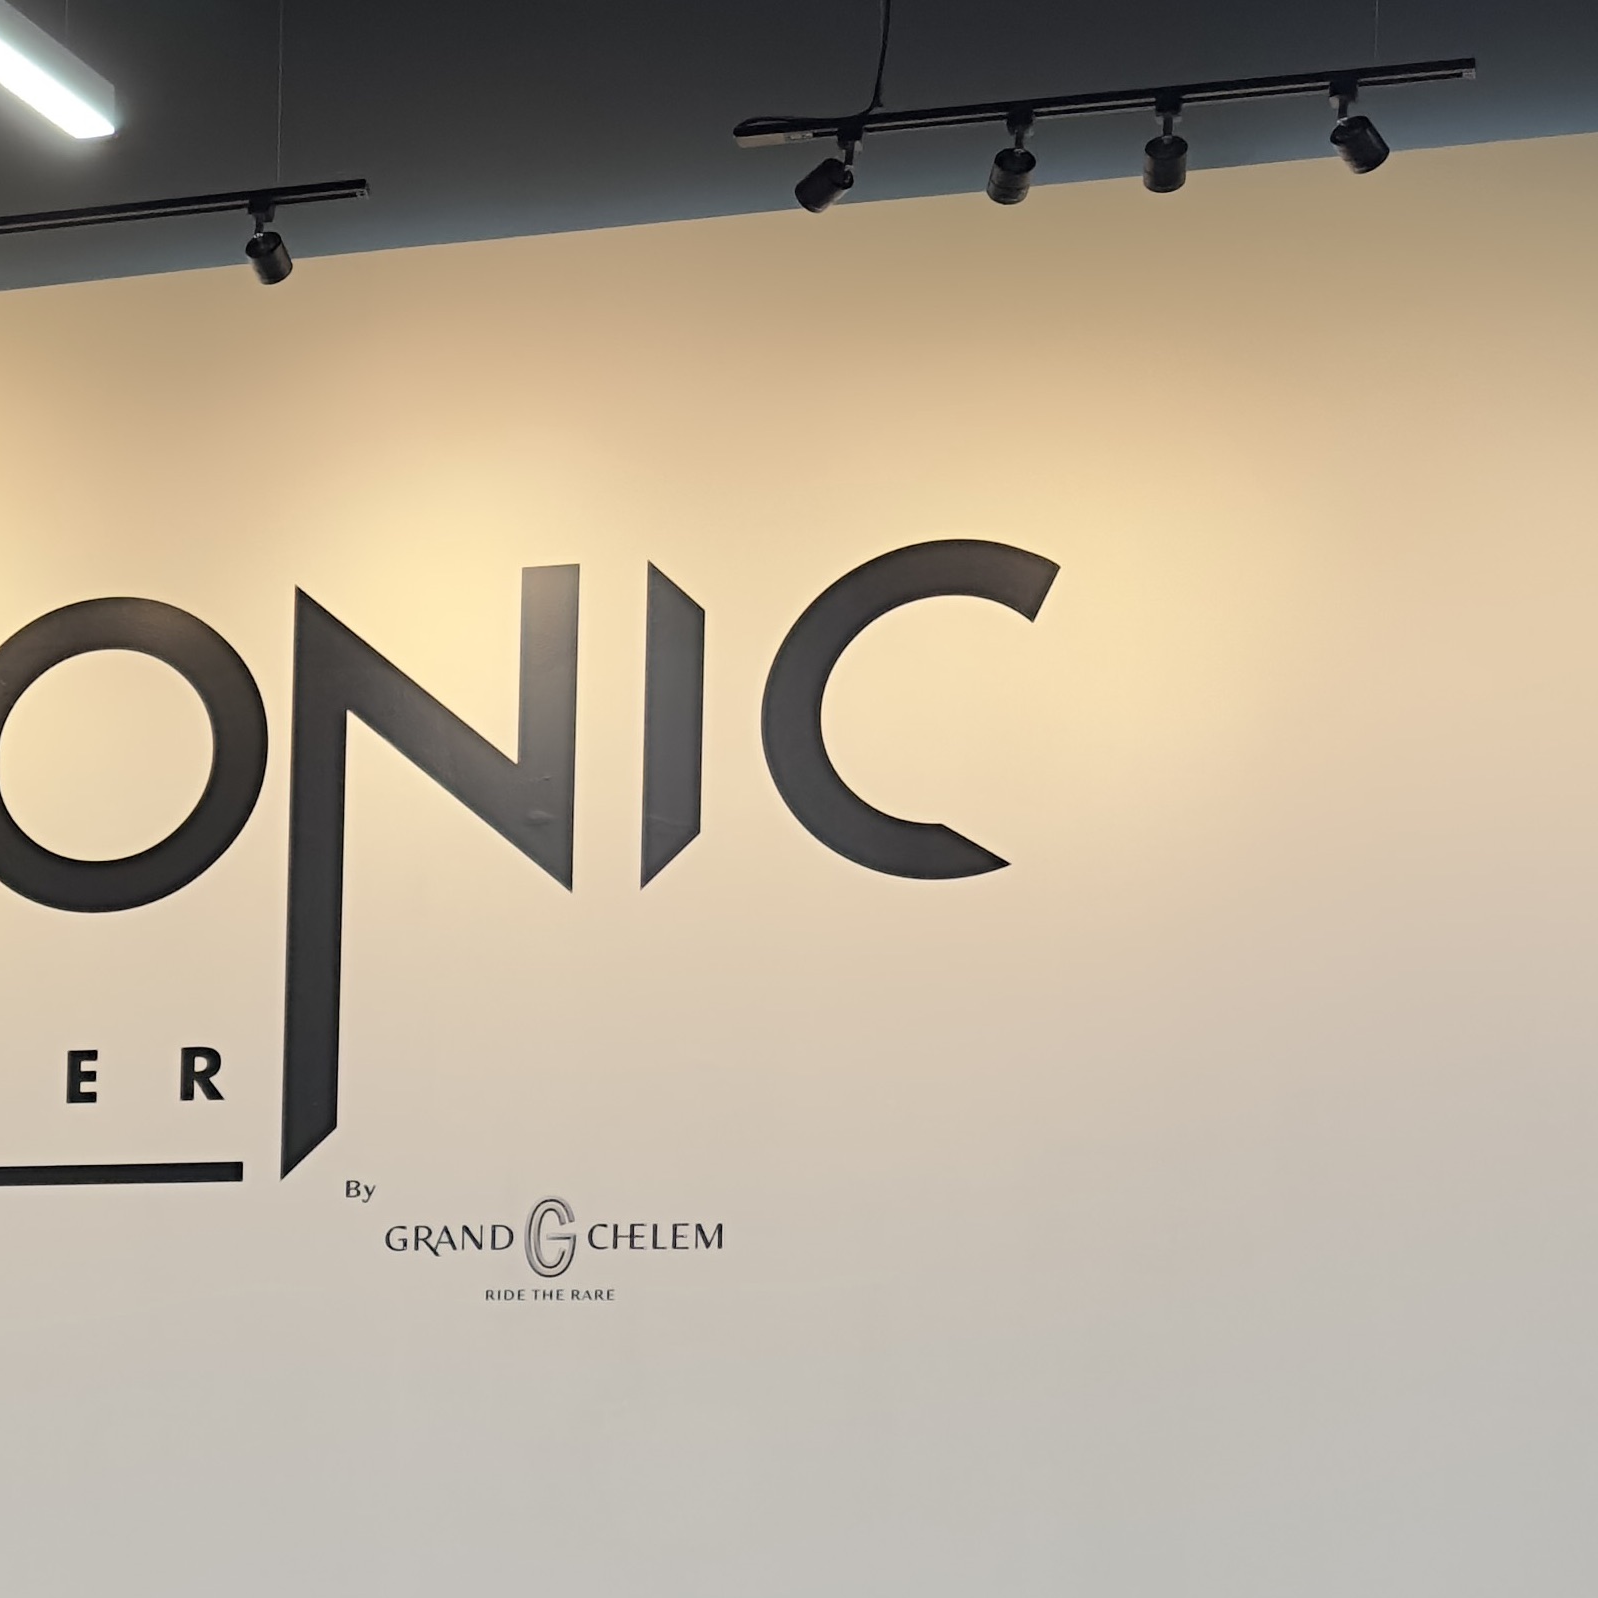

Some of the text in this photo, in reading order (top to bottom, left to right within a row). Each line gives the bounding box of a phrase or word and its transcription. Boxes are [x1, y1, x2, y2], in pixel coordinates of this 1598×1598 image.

[345, 1179, 376, 1204] By
[384, 1224, 515, 1257] GRAND
[587, 1222, 723, 1250] CHELEM
[485, 1289, 614, 1301] RIDE THE RARE
